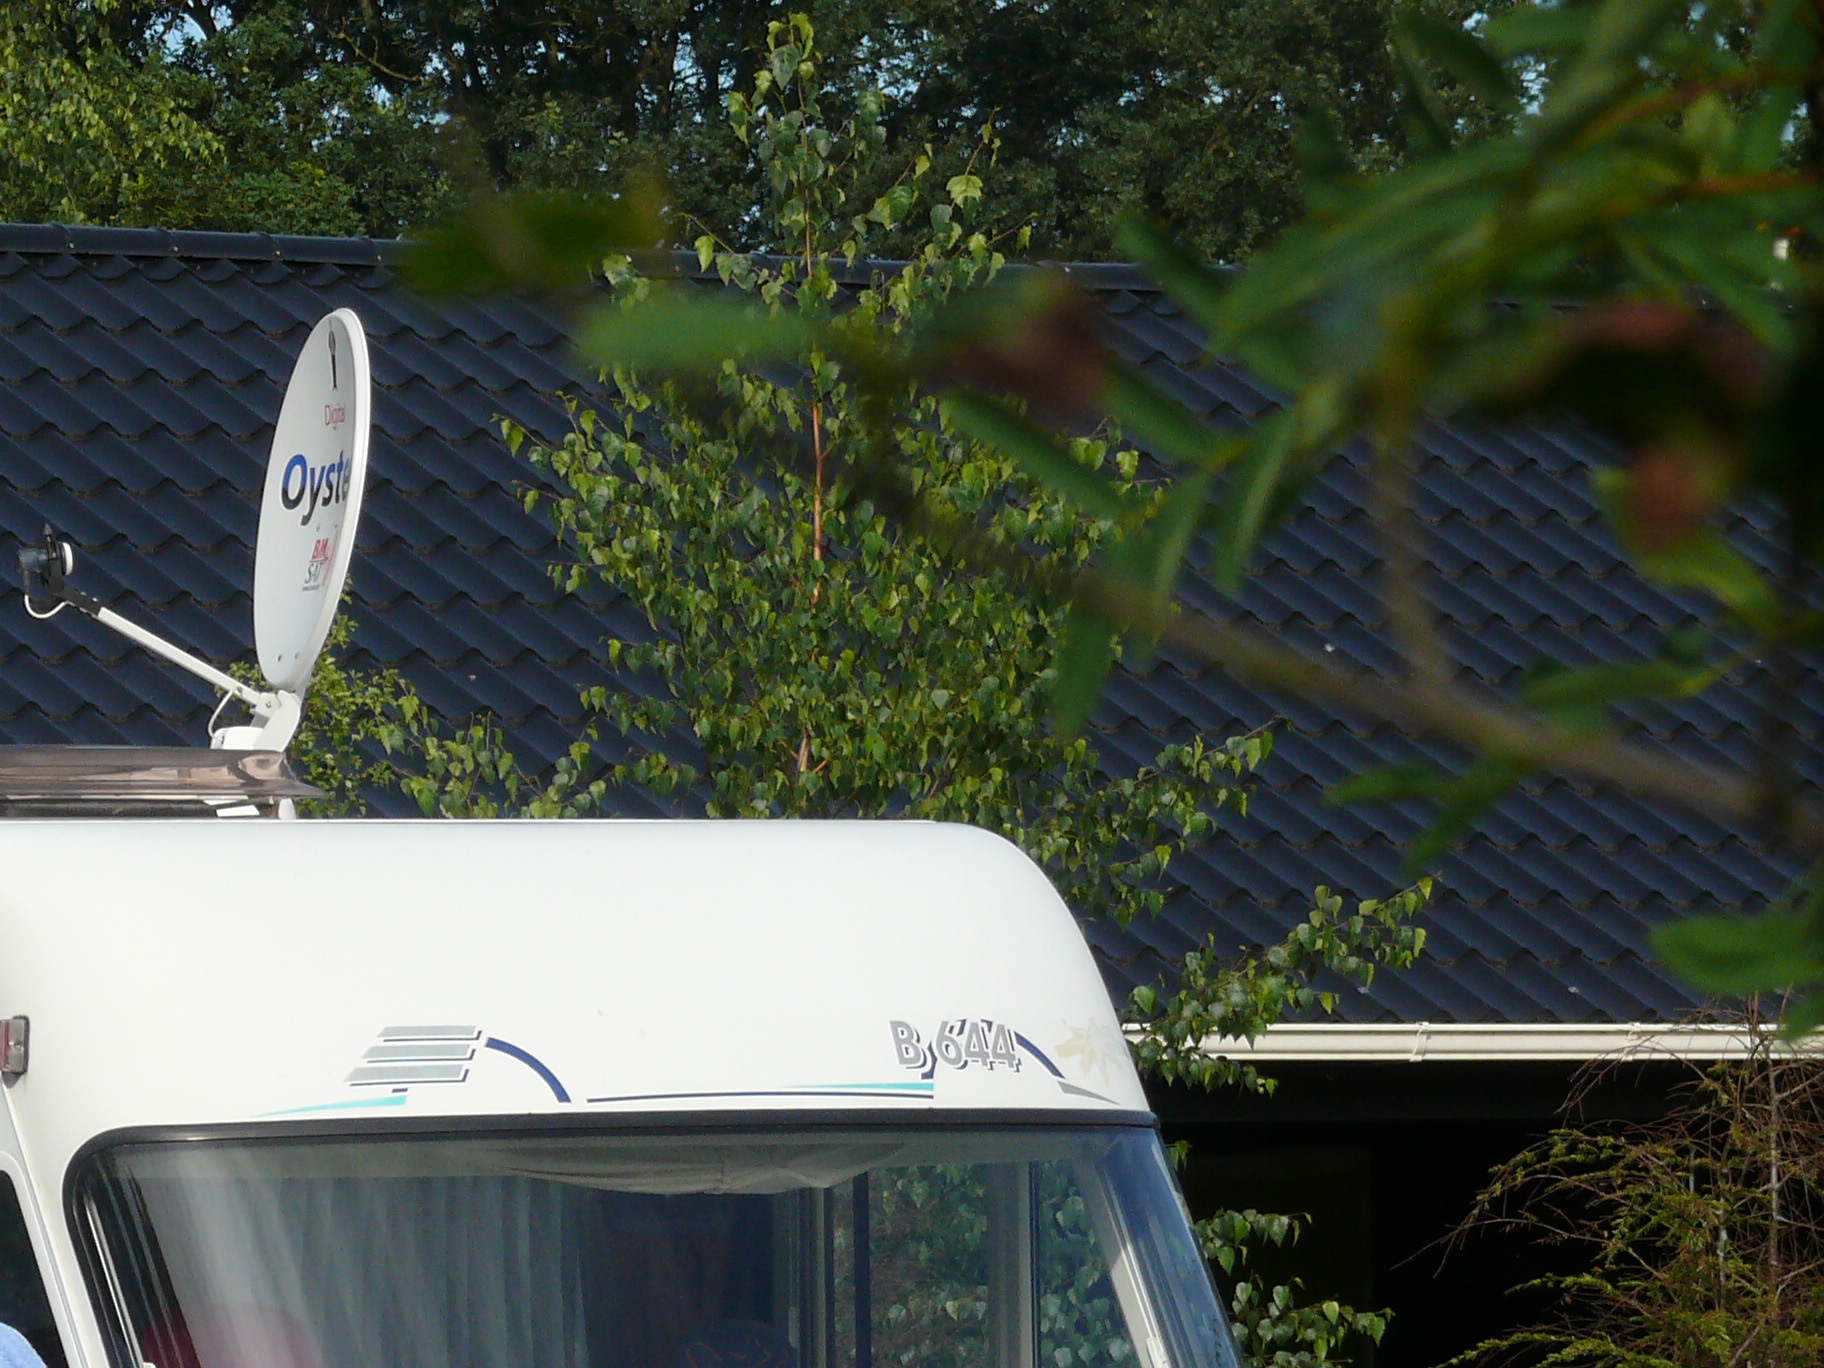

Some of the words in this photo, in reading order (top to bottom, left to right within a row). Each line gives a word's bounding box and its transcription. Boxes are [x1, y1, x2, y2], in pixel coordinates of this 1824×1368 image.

[281, 450, 350, 526] Oyste
[889, 1020, 926, 1069] B
[935, 1018, 1022, 1073] 644
